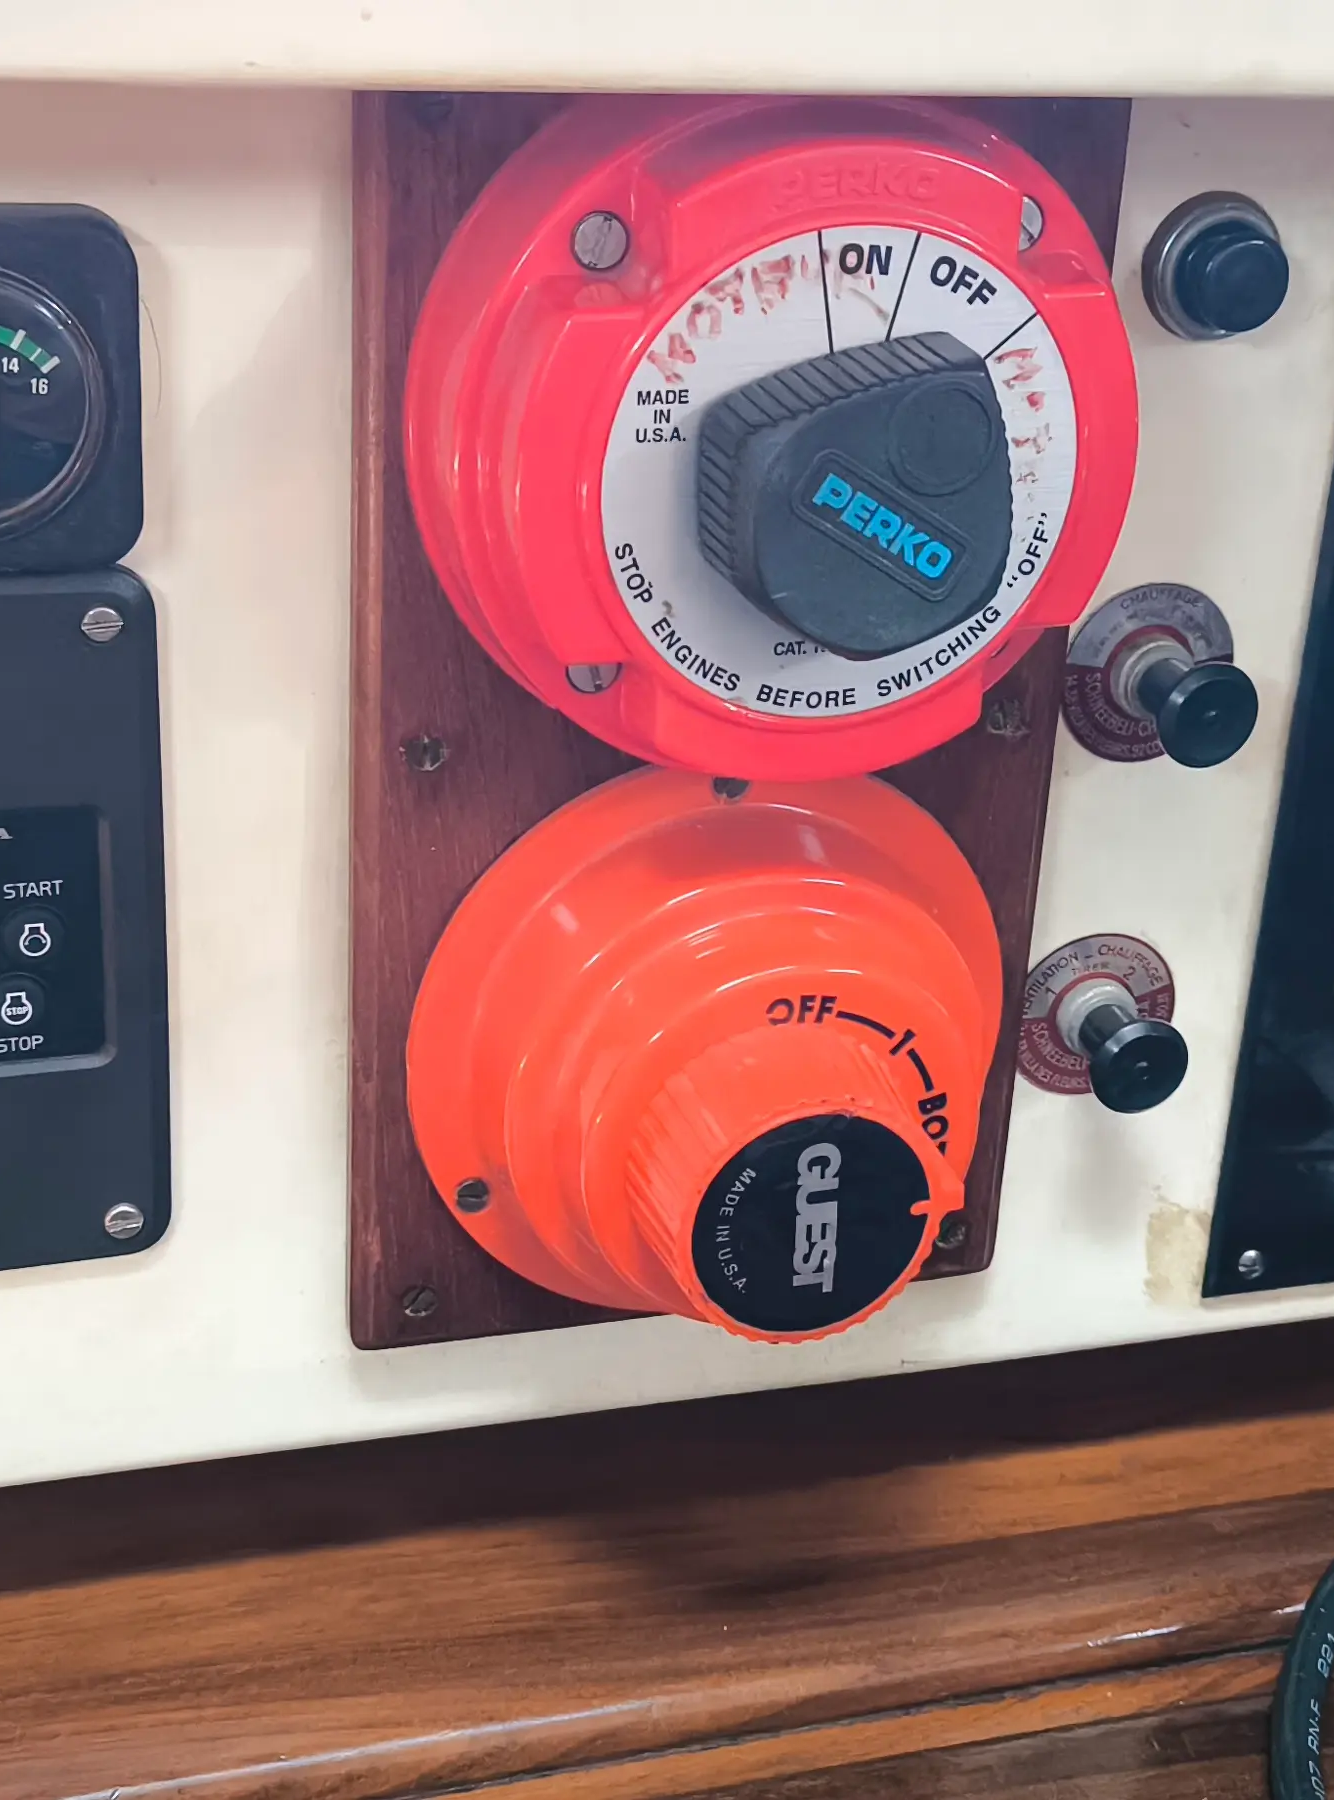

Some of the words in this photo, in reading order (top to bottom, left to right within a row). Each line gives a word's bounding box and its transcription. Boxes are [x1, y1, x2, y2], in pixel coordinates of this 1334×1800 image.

[838, 242, 894, 276] ON
[929, 254, 998, 306] OFF
[1, 356, 20, 374] 14
[30, 378, 49, 395] 16
[636, 388, 690, 406] MADE
[653, 409, 671, 425] IN
[635, 427, 686, 444] U.S.A.
[811, 472, 955, 582] PERKO
[614, 542, 654, 606] STOP
[651, 616, 742, 693] ENGINES
[755, 684, 858, 710] BEFORE
[875, 605, 1003, 699] SWITCHING
[773, 641, 807, 656] CAT.
[2, 880, 64, 900] START
[5, 1004, 30, 1016] STOP
[765, 995, 838, 1026] OFF
[718, 1167, 758, 1218] MADE
[792, 1142, 843, 1293] GUEST
[715, 1225, 731, 1243] IN
